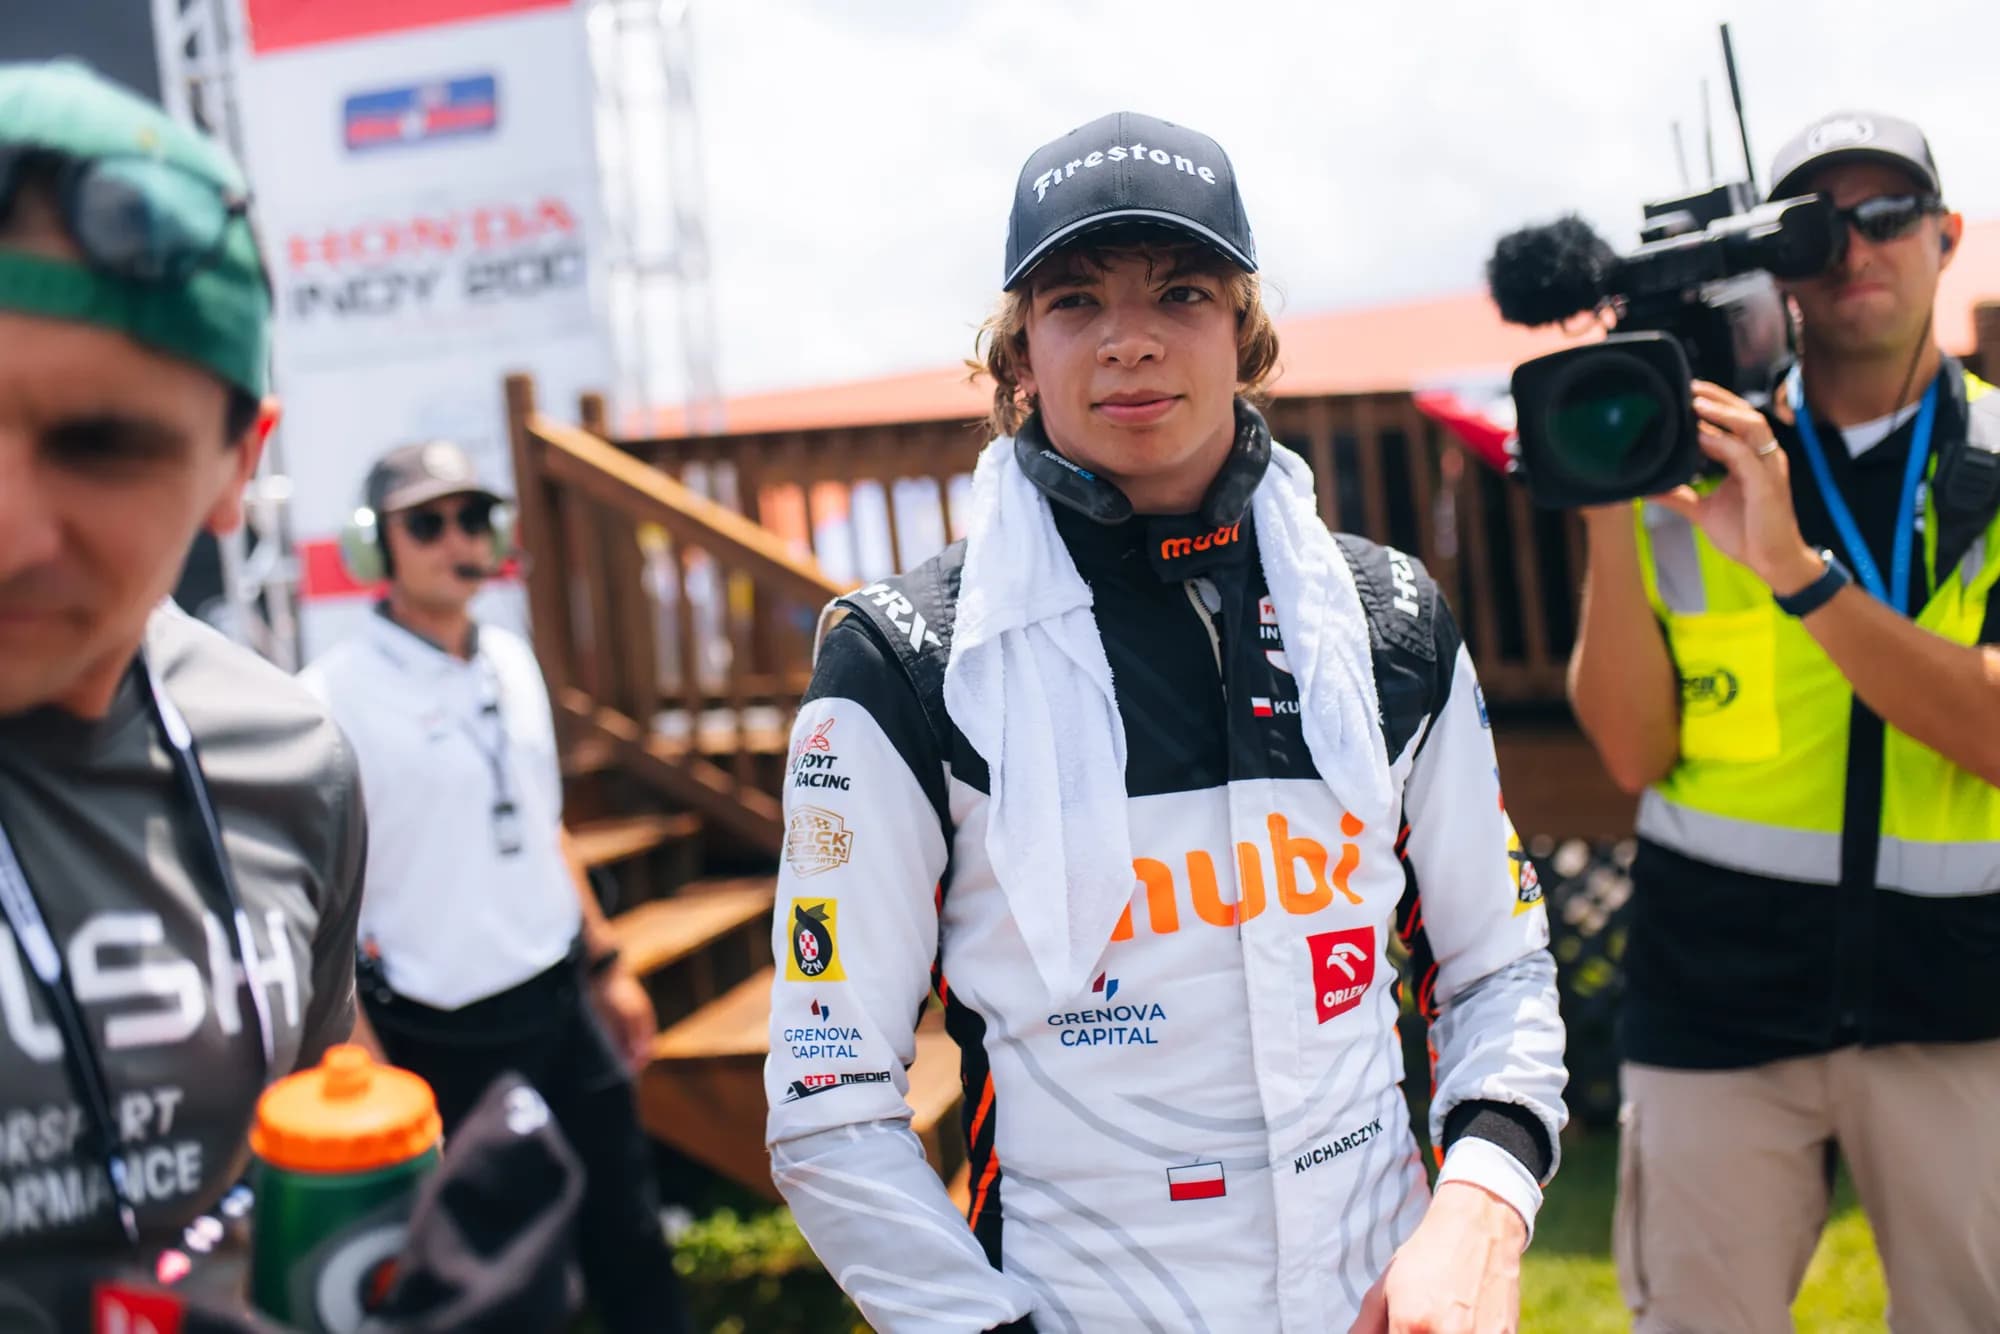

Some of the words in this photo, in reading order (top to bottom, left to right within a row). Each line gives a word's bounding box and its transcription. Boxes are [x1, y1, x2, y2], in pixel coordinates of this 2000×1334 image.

[1032, 143, 1216, 203] Firestone
[287, 196, 576, 272] HONDA
[290, 266, 439, 318] INDY
[861, 583, 943, 654] HRX
[795, 771, 851, 791] RACING
[801, 959, 825, 975] PZM
[1047, 1003, 1167, 1027] GRENOVA
[784, 1027, 863, 1042] GRENOVA
[1060, 1027, 1158, 1047] CAPITAL
[792, 1045, 858, 1059] CAPITAL
[840, 1070, 891, 1085] MEDIA
[1294, 1118, 1384, 1174] KUCHARCZYK
